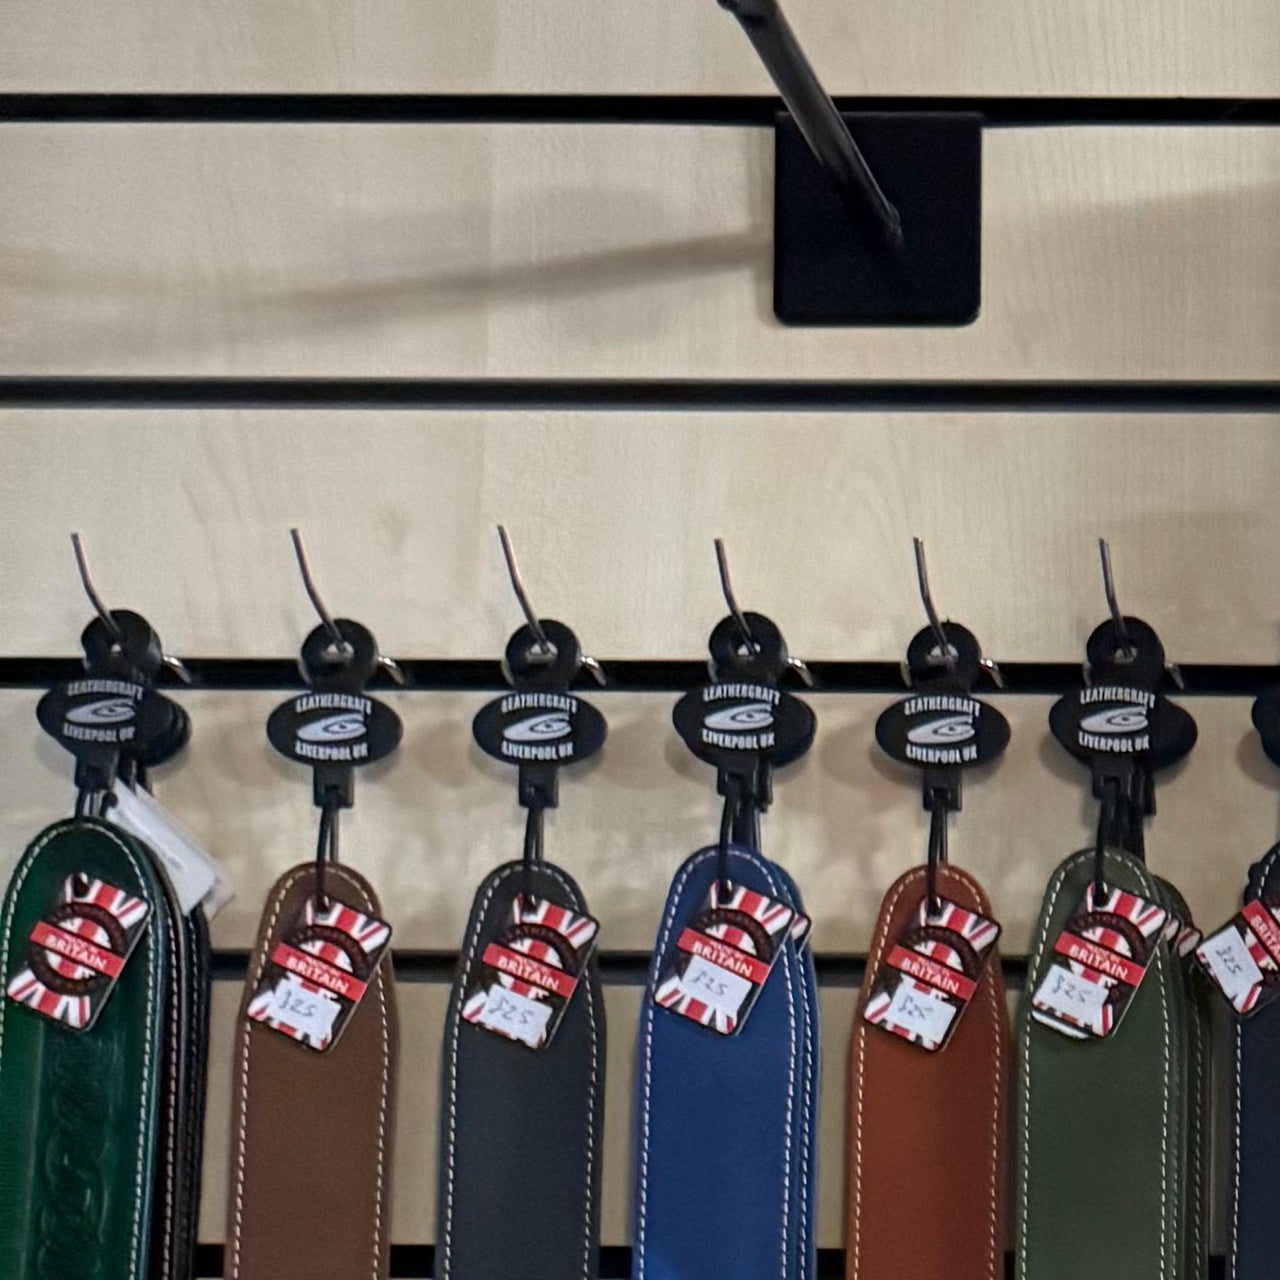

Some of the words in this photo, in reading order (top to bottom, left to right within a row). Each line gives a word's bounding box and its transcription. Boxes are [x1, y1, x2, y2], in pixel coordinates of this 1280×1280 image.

[703, 684, 780, 705] LEATHERCRAFT
[904, 696, 980, 717] LEATHERCRAFT
[1080, 686, 1155, 708] LEATHERCRAFT
[702, 728, 758, 749] LIVERPOOL
[1079, 731, 1133, 752] LIVERPOOL
[906, 743, 961, 764] LIVERPOOL
[45, 934, 107, 969] BRITAIN
[693, 941, 753, 977] BRITAIN
[1069, 944, 1128, 979] BRITAIN
[285, 955, 349, 993] BRITAIN
[498, 955, 560, 991] BRITAIN
[901, 957, 960, 993] BRITAIN
